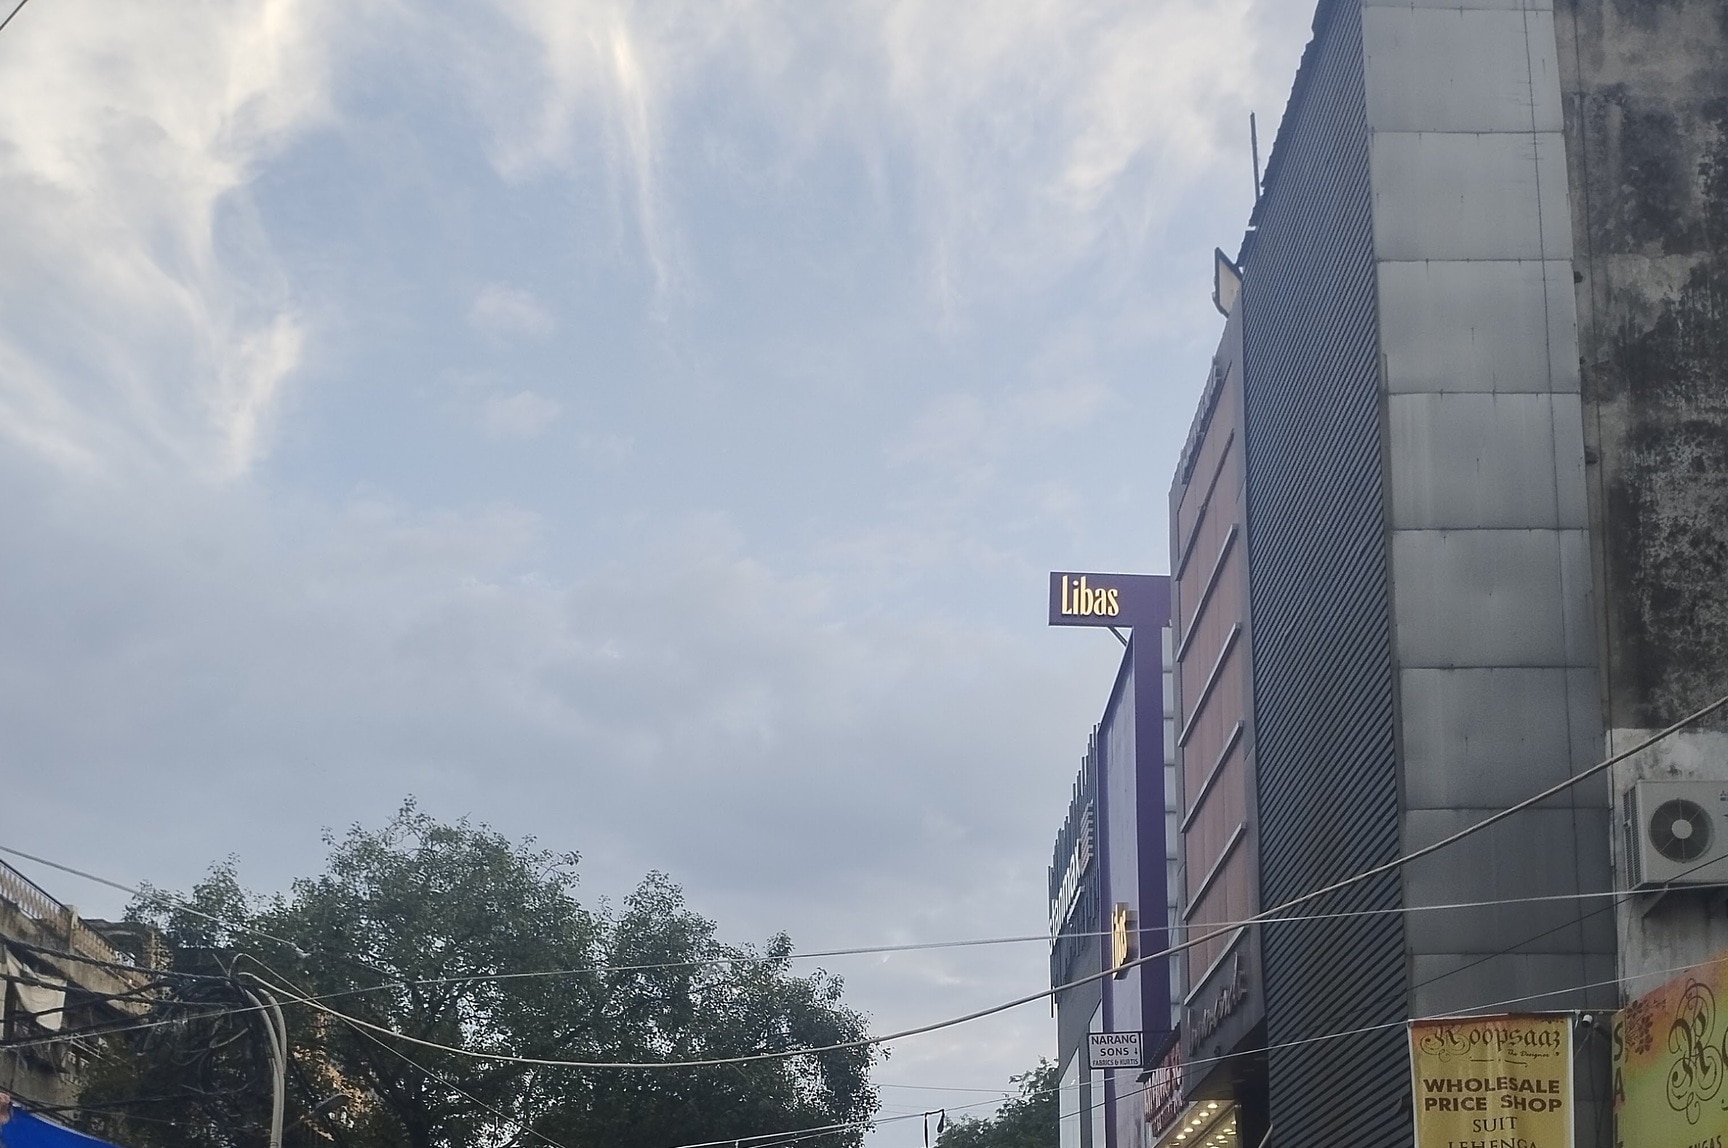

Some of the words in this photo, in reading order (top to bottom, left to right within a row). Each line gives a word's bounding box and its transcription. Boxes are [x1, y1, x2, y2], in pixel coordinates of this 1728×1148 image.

[1062, 575, 1120, 617] Libas
[1091, 1035, 1137, 1045] NARANG
[1100, 1047, 1130, 1057] SONS
[1119, 1058, 1139, 1066] KURTIS
[1423, 1076, 1560, 1094] WHOLESALE
[1424, 1096, 1488, 1112] PRICE
[1500, 1094, 1563, 1113] SHOP
[1472, 1116, 1518, 1133] SUIT
